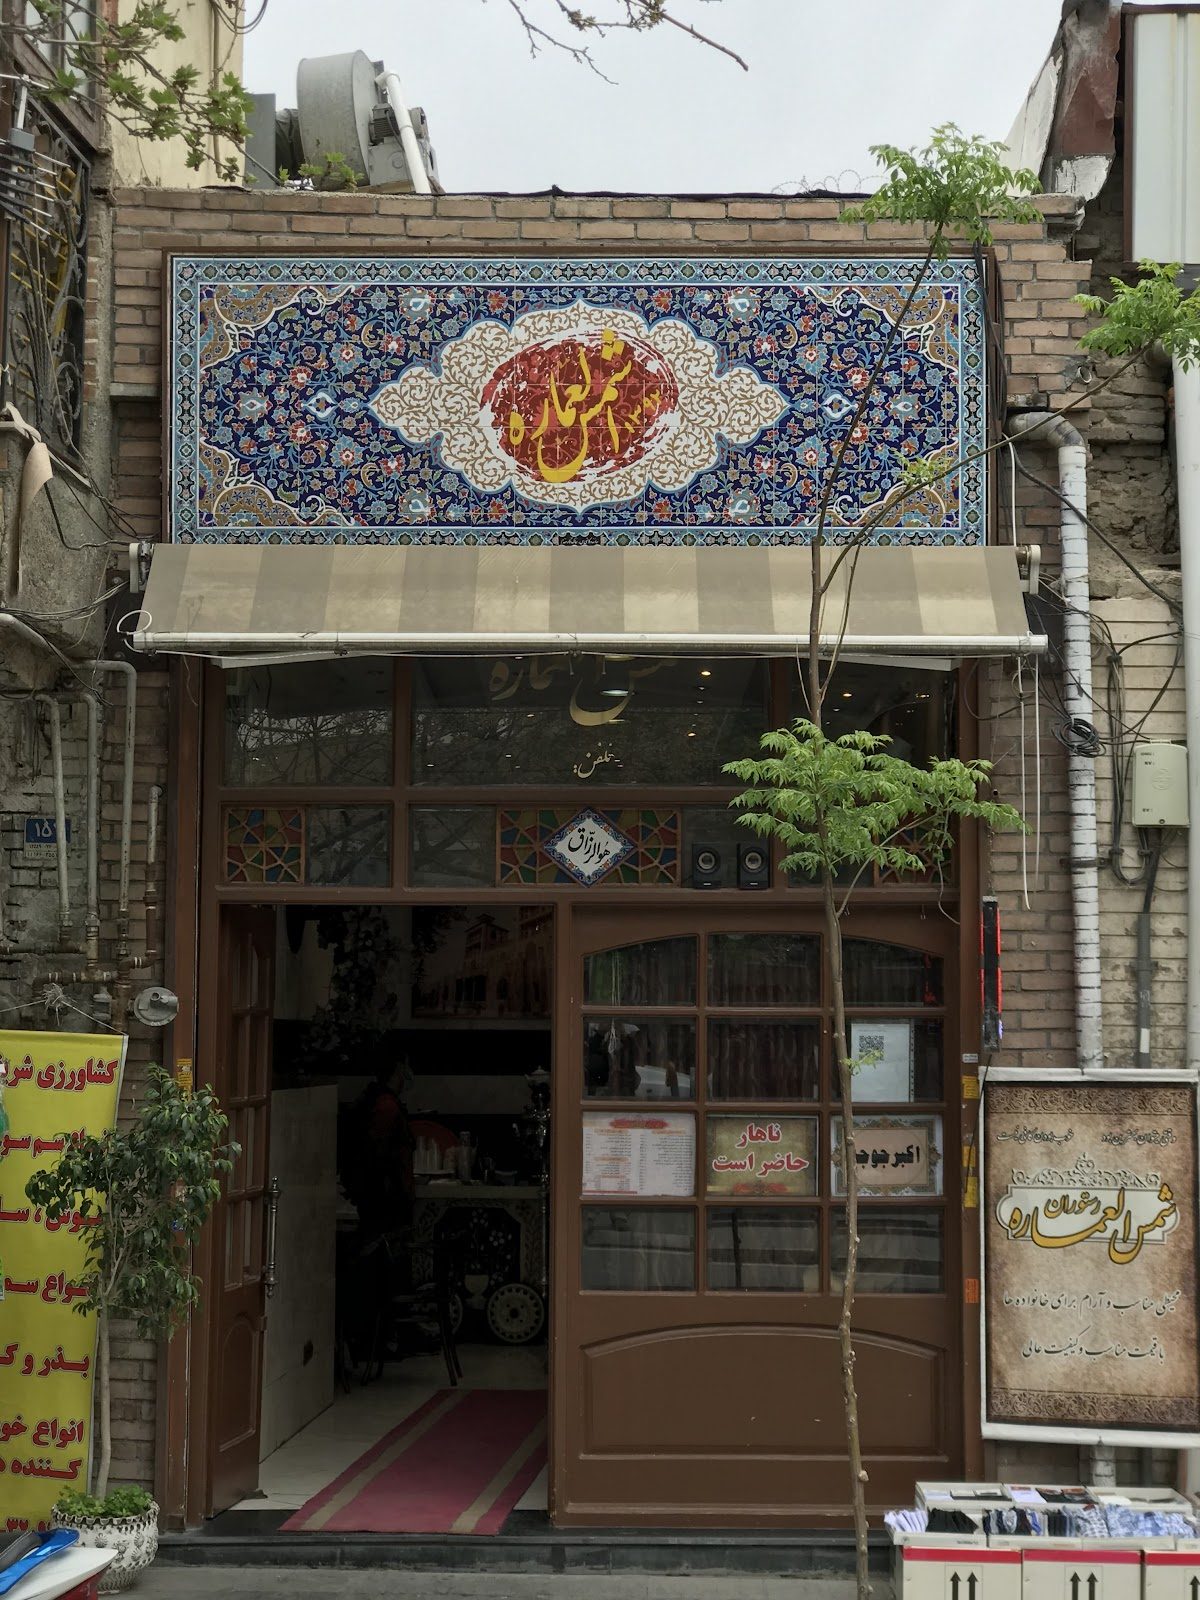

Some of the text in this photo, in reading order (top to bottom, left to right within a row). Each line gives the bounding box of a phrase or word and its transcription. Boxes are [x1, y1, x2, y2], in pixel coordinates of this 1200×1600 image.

[509, 328, 632, 483] شمس العماره
[35, 817, 57, 837] ۱۵
[36, 1057, 119, 1092] کشاورزی
[735, 1122, 783, 1148] ناهار
[712, 1152, 810, 1177] حاضر است
[856, 1144, 920, 1169] اکبر جوج
[1044, 1190, 1102, 1219] رستوران
[1008, 1186, 1132, 1249] العماره
[1108, 1183, 1178, 1266] شمس
[1050, 1292, 1077, 1311] برای
[1079, 1291, 1107, 1320] آرام
[1105, 1299, 1112, 1309] و
[1112, 1297, 1154, 1316] مناسب
[1155, 1289, 1181, 1316] محیطی
[1022, 1339, 1042, 1359] عالی
[1044, 1325, 1092, 1357] کیفیت
[1084, 1342, 1127, 1361] مناسب
[1127, 1337, 1158, 1358] قیمت
[20, 1353, 35, 1375] و
[36, 1345, 91, 1379] بذر
[0, 1416, 85, 1449] انواع خو
[10, 1456, 84, 1481] کننده
